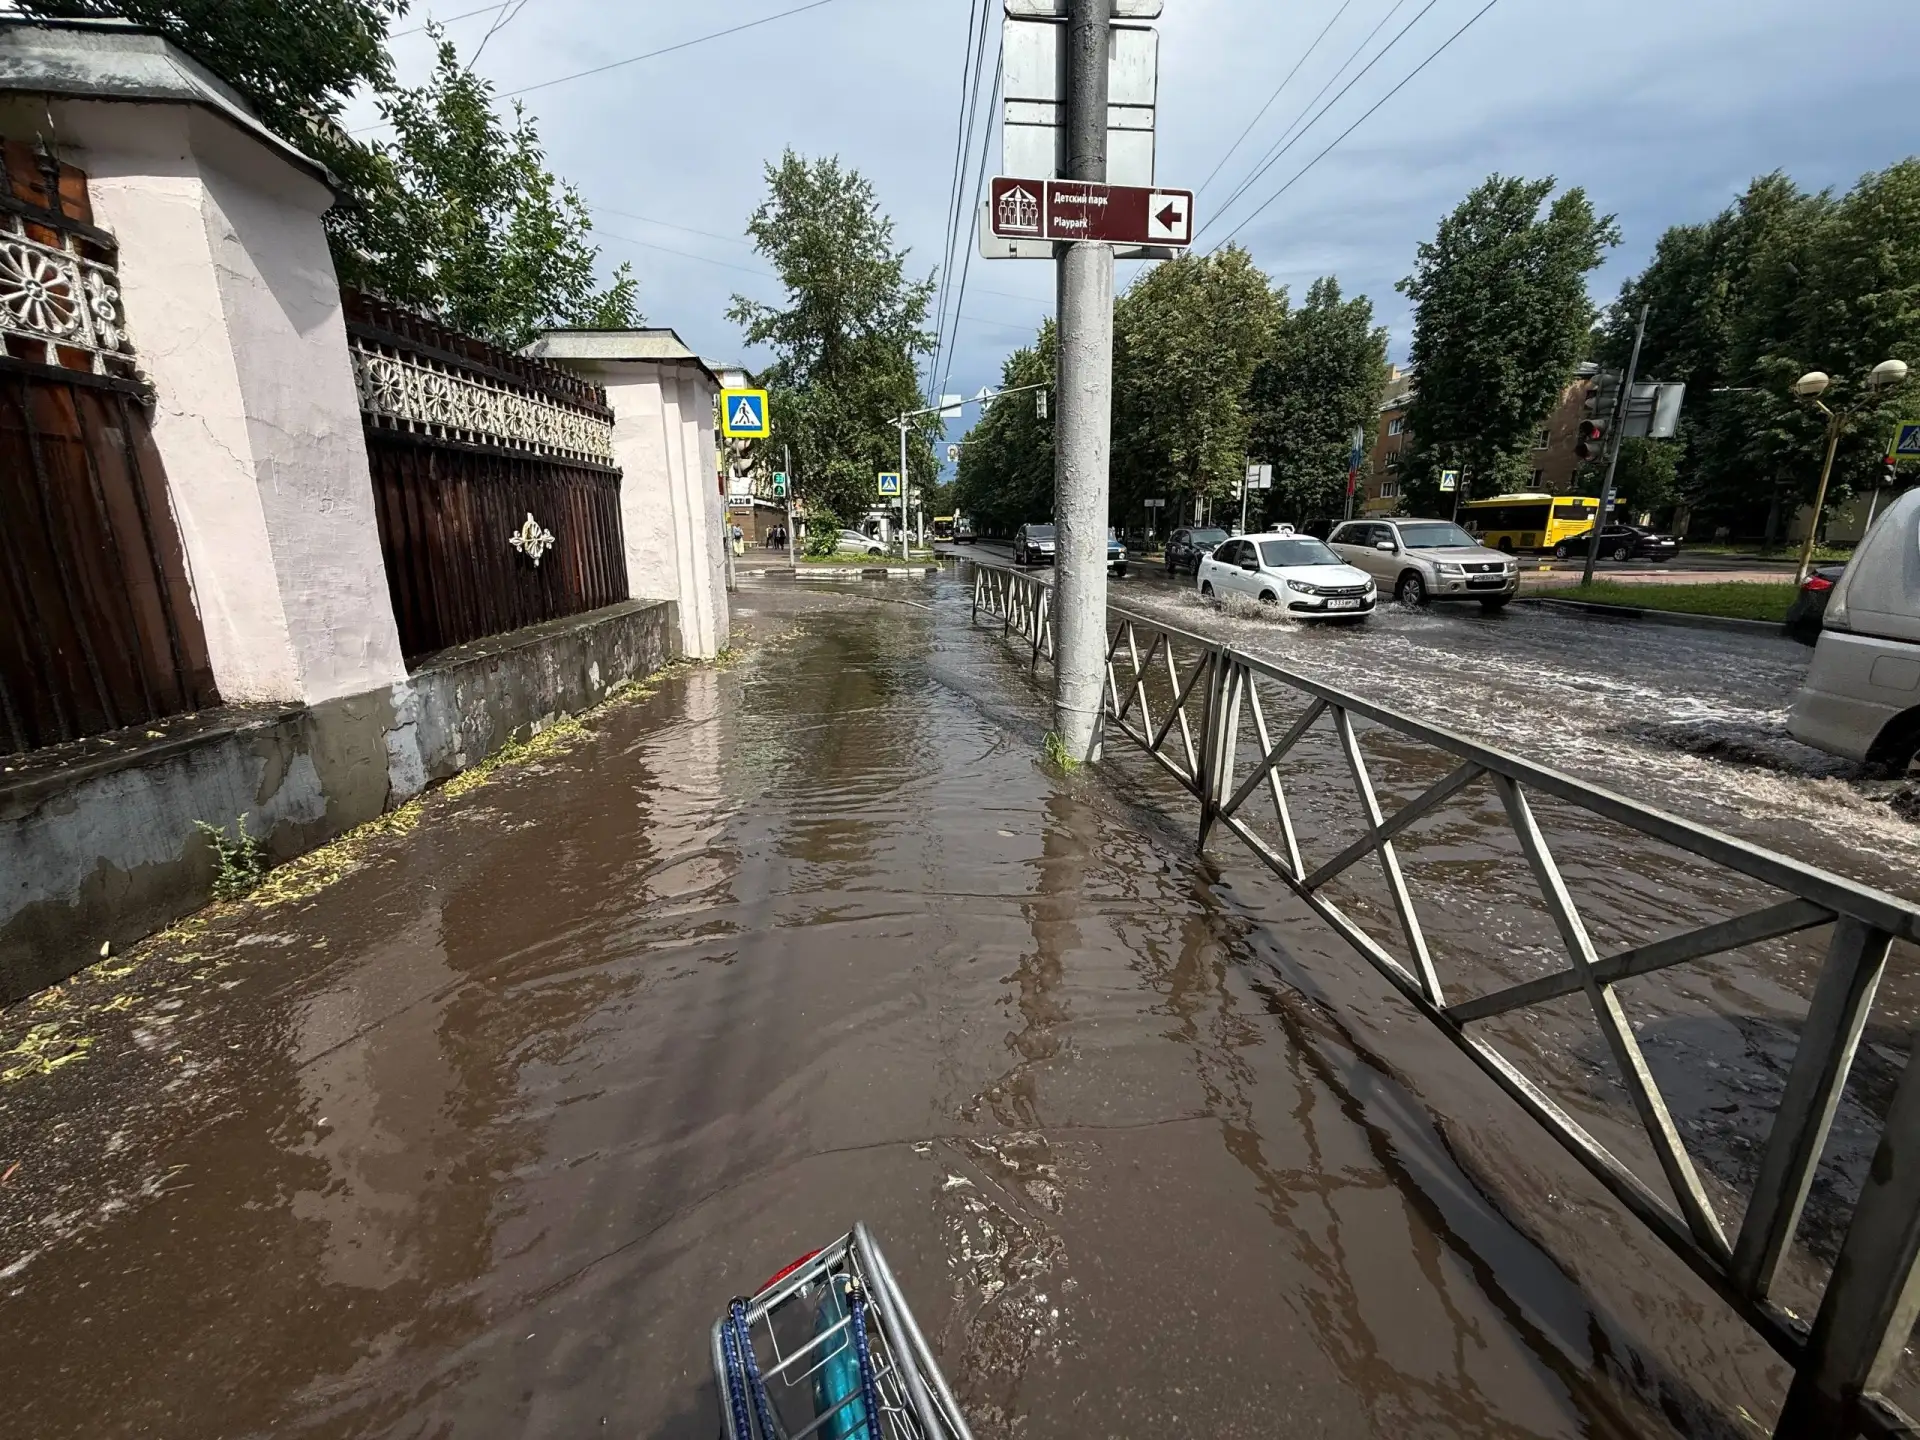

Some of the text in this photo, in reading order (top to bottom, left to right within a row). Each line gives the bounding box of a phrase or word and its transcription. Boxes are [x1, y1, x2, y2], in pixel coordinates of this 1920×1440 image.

[1054, 192, 1107, 206] Детский парк
[1054, 216, 1088, 229] Playpark
